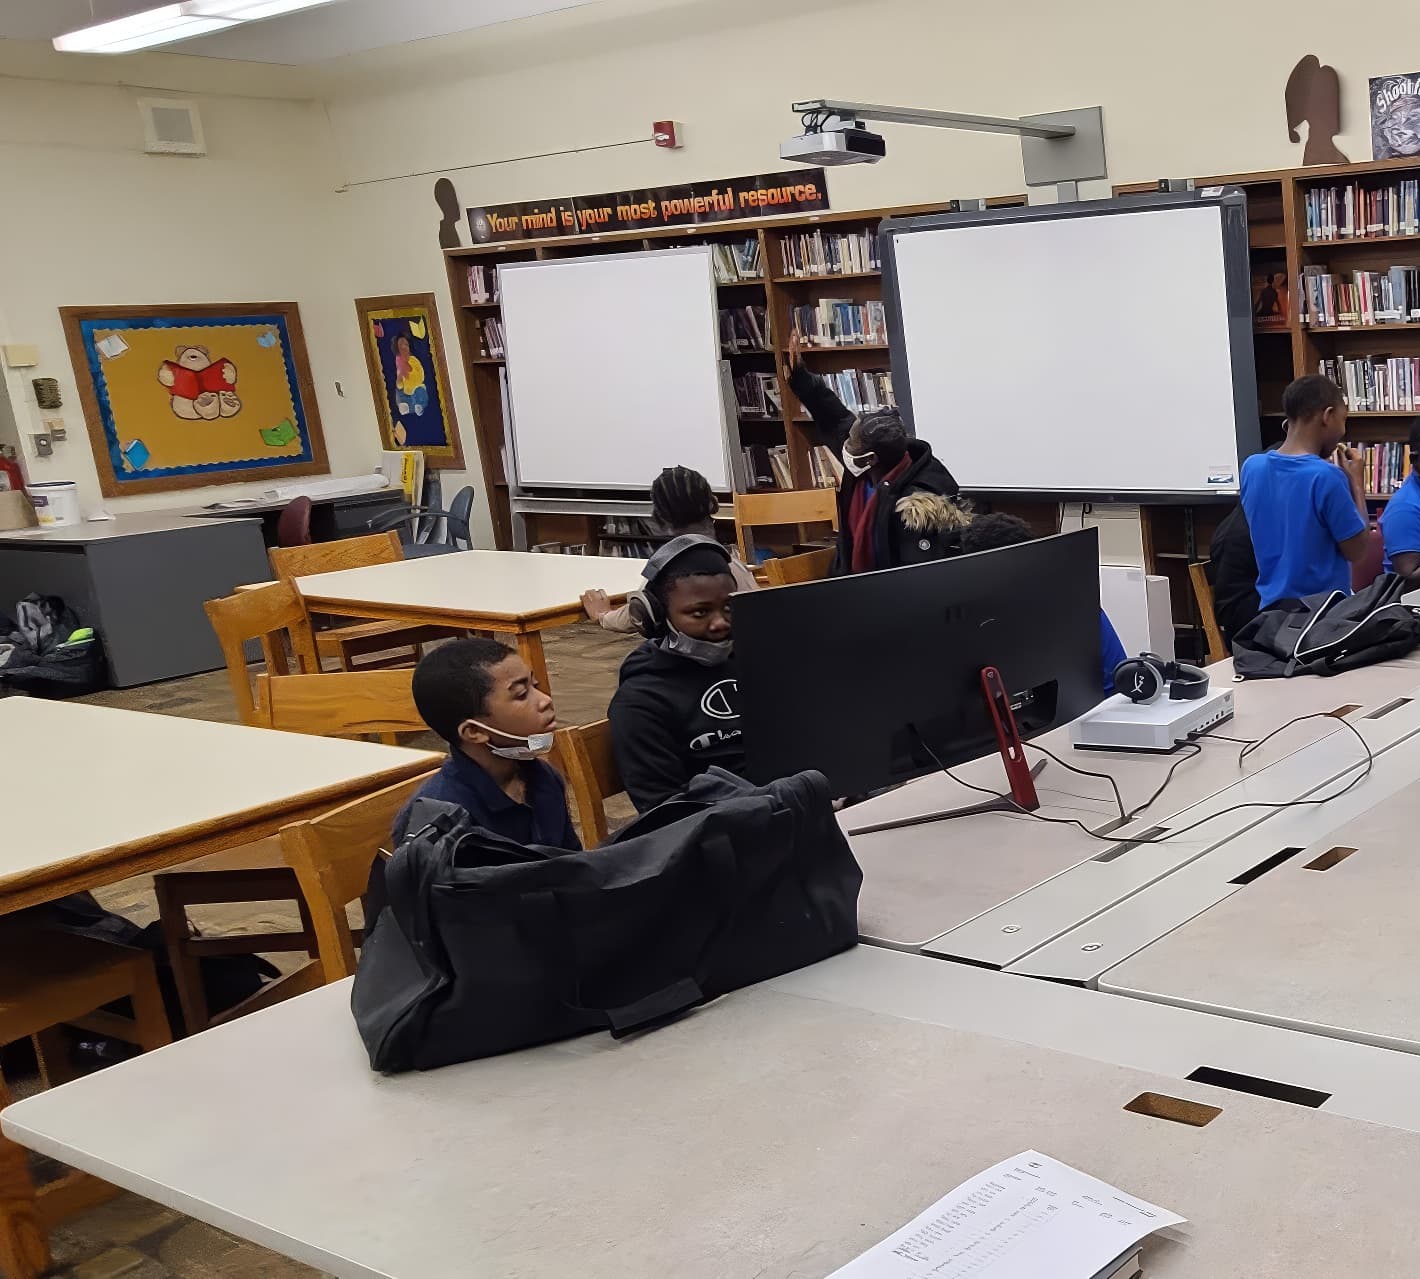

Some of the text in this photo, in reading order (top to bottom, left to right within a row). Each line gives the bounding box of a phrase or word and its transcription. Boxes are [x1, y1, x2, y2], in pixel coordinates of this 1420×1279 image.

[1376, 78, 1414, 112] Shoot
[486, 181, 823, 234] Your mind is your most powerful resource.
